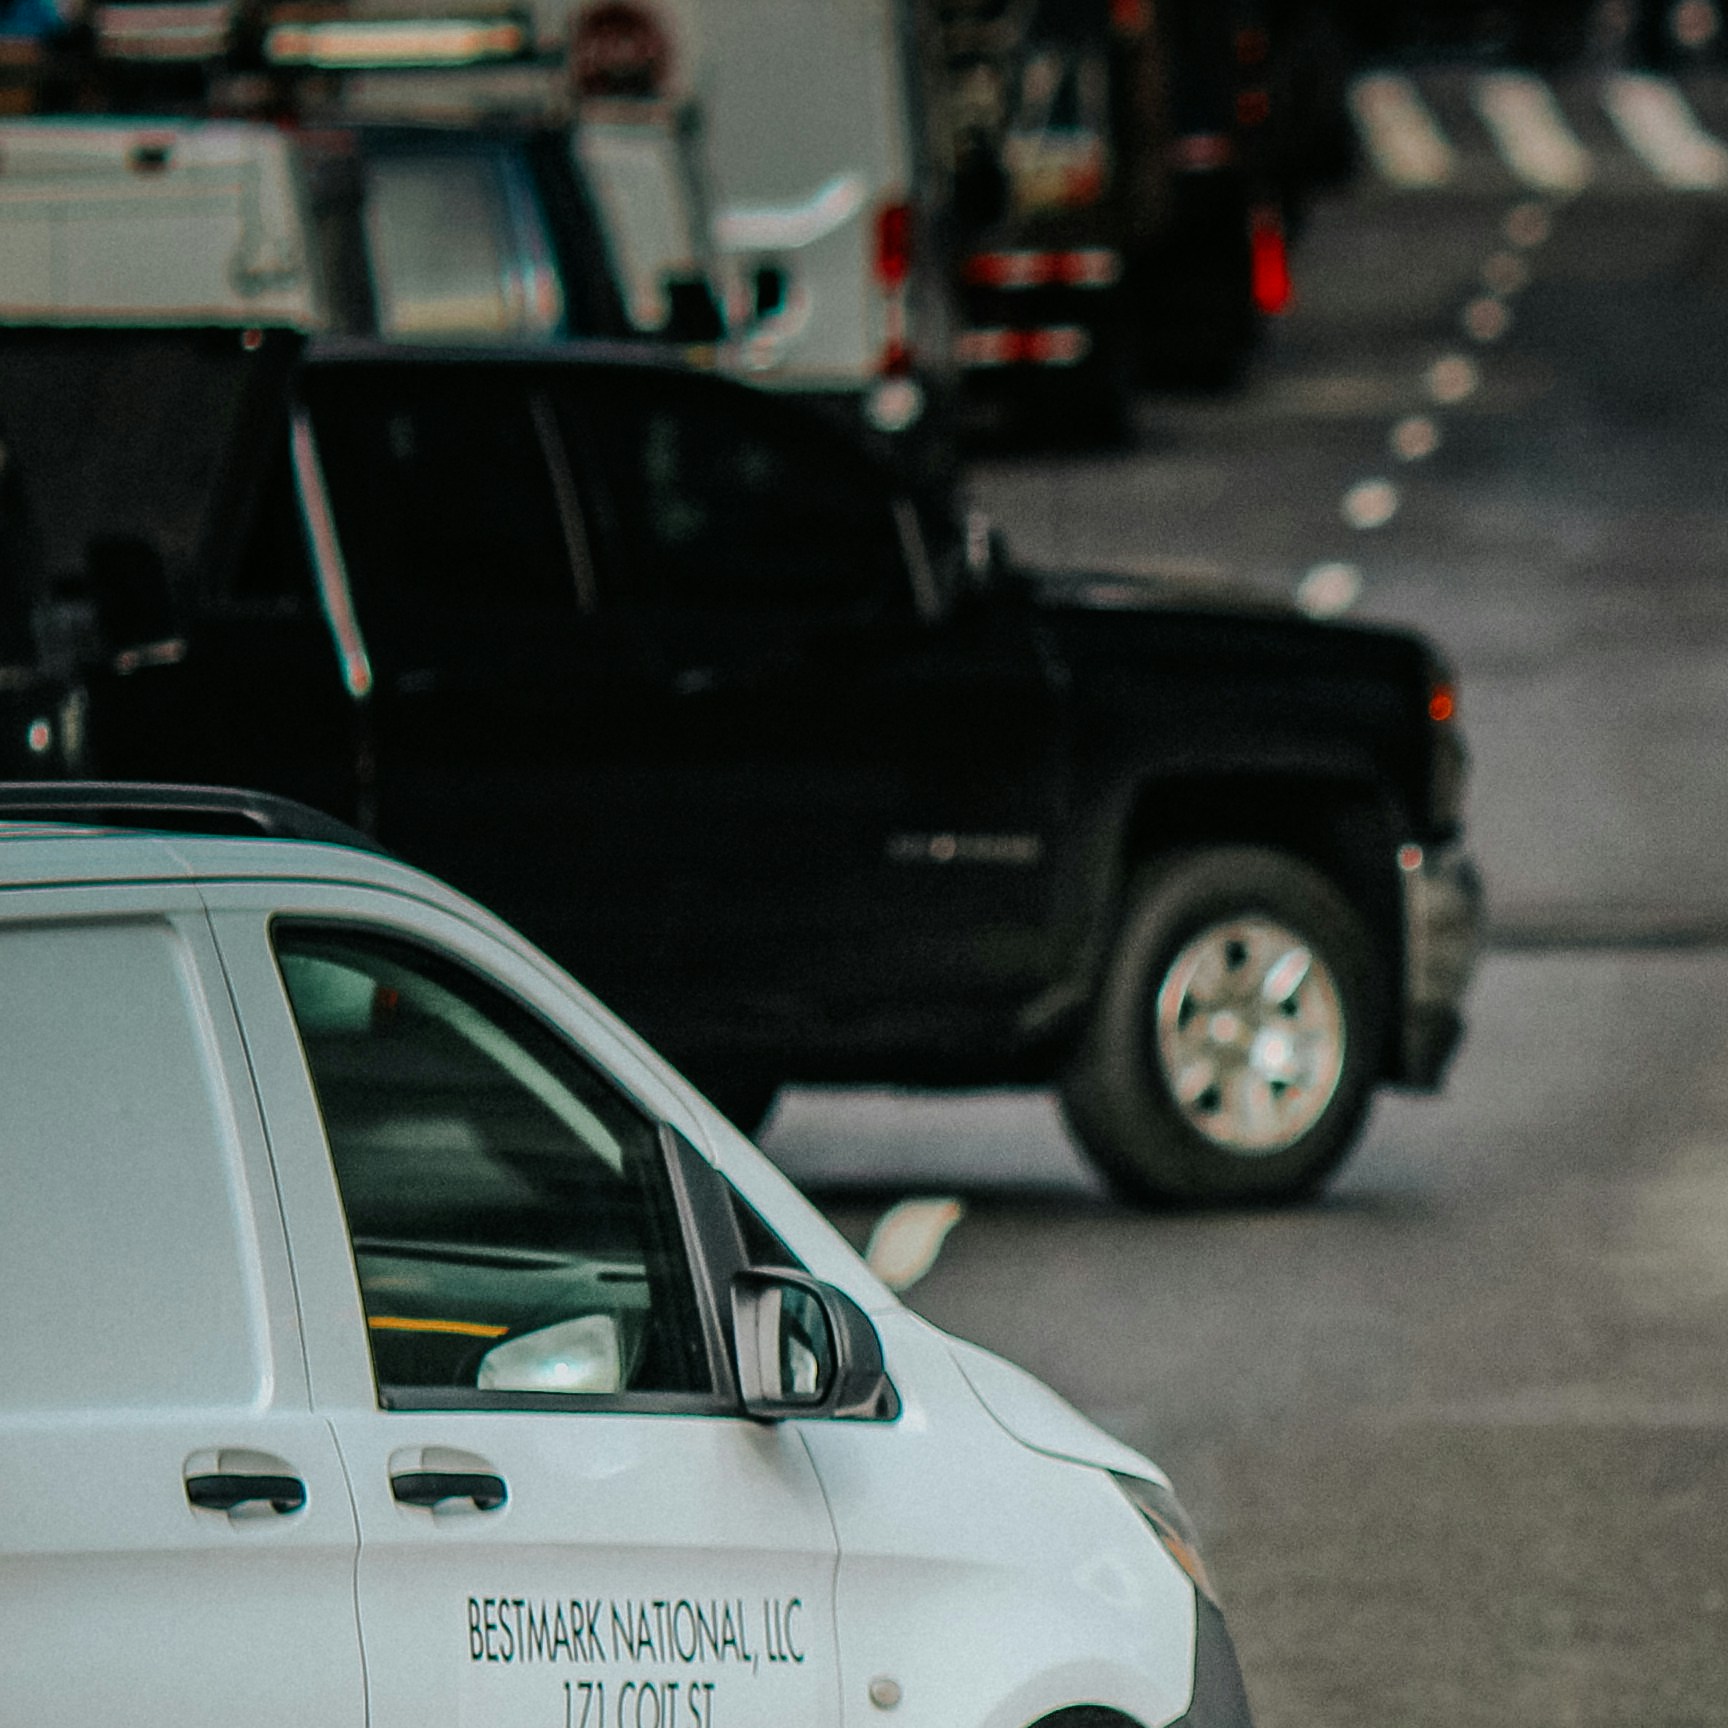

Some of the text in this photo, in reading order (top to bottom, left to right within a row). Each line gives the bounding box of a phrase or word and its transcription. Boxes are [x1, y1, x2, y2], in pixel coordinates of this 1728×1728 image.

[468, 1597, 804, 1675] BESTMARK NATIONAL, LLC
